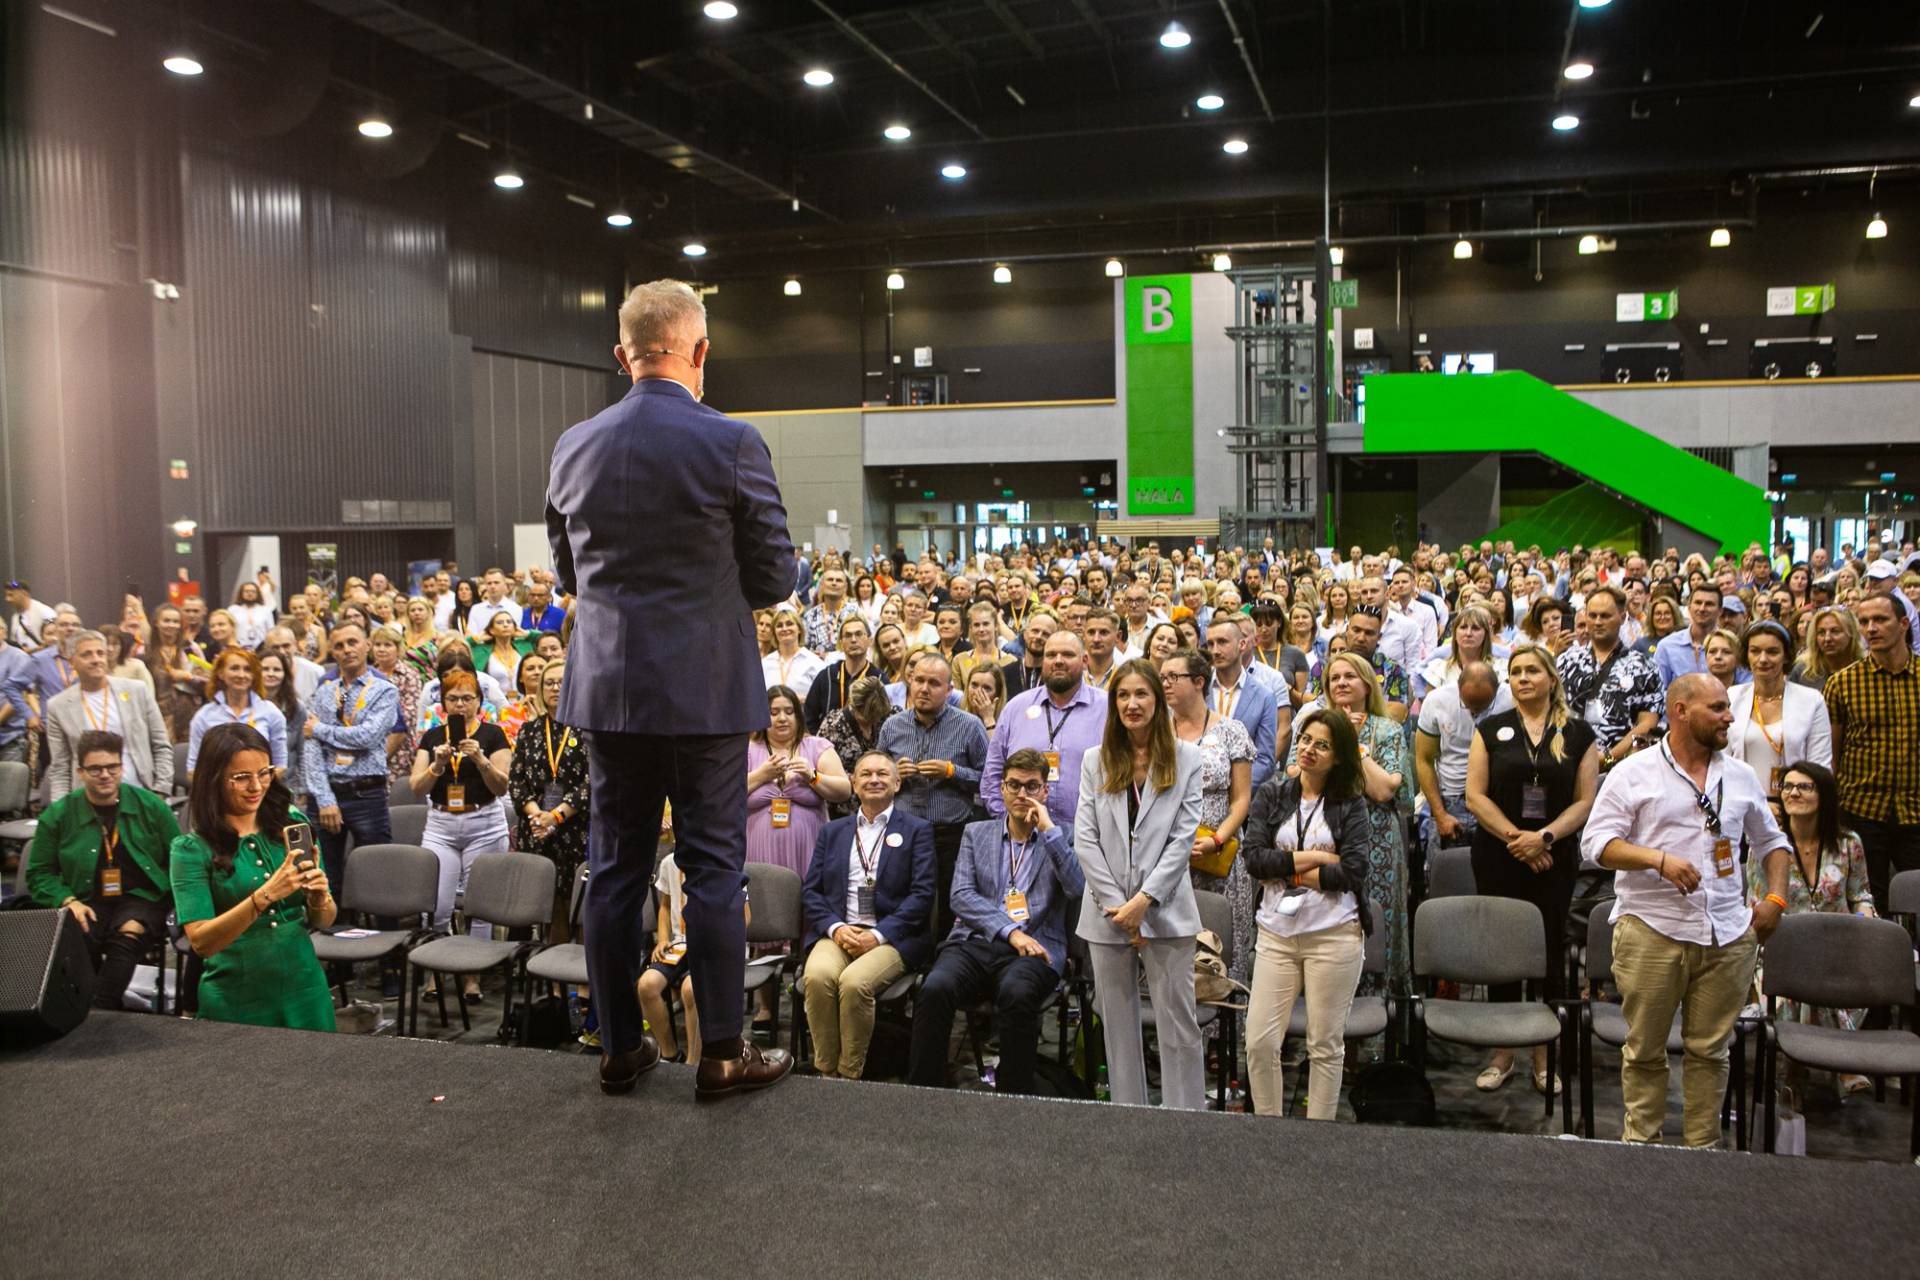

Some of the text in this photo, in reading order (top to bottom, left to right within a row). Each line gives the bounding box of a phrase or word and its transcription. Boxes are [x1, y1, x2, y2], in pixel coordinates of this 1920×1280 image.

[1650, 298, 1663, 315] 3
[1802, 292, 1815, 309] 2
[1143, 286, 1174, 333] B
[1135, 487, 1185, 504] HALA
